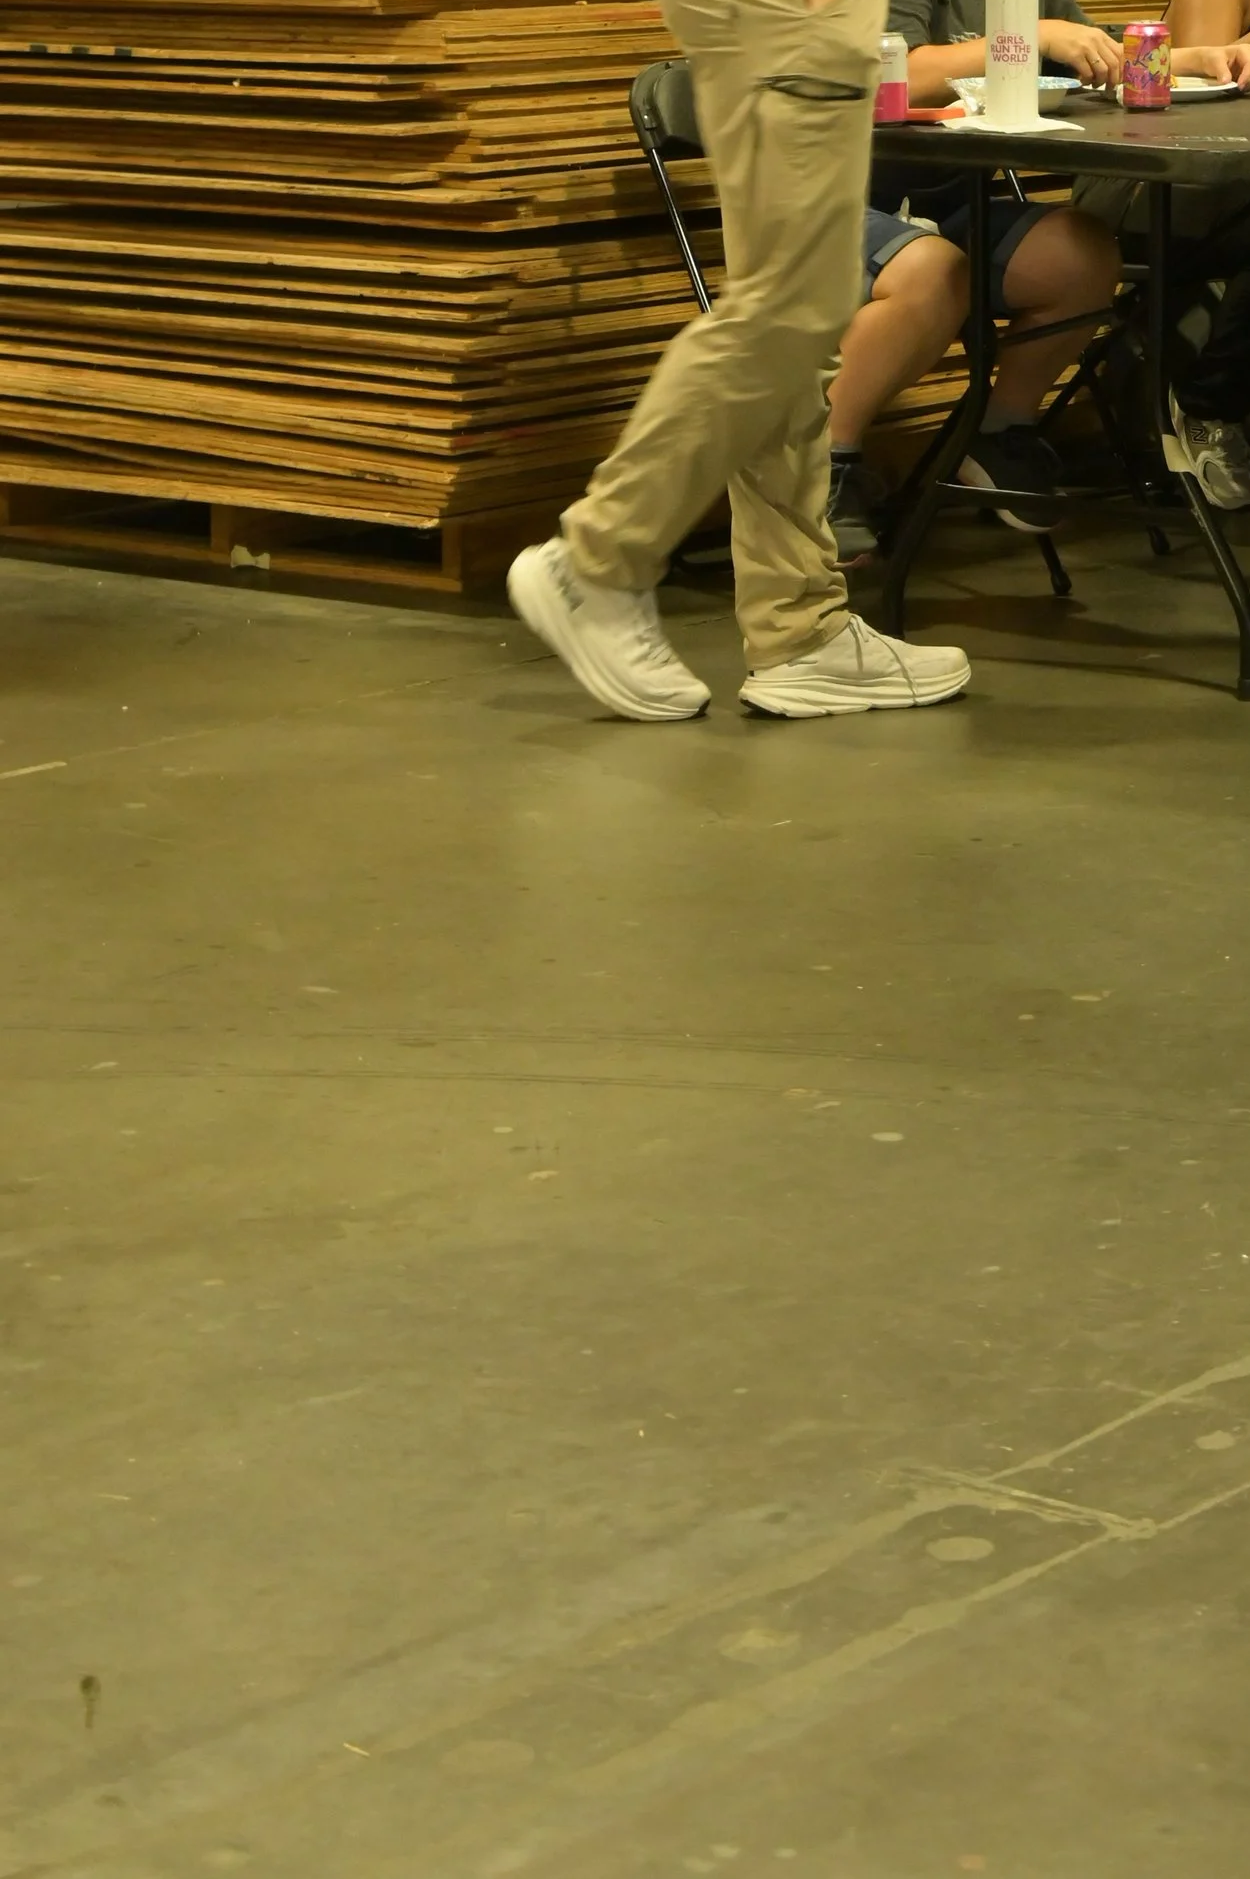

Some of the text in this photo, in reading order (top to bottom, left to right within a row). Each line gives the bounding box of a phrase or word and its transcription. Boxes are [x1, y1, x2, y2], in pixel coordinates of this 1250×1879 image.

[997, 35, 1024, 44] GIRLS
[991, 44, 1031, 53] RUN THE
[993, 53, 1028, 62] WORLD
